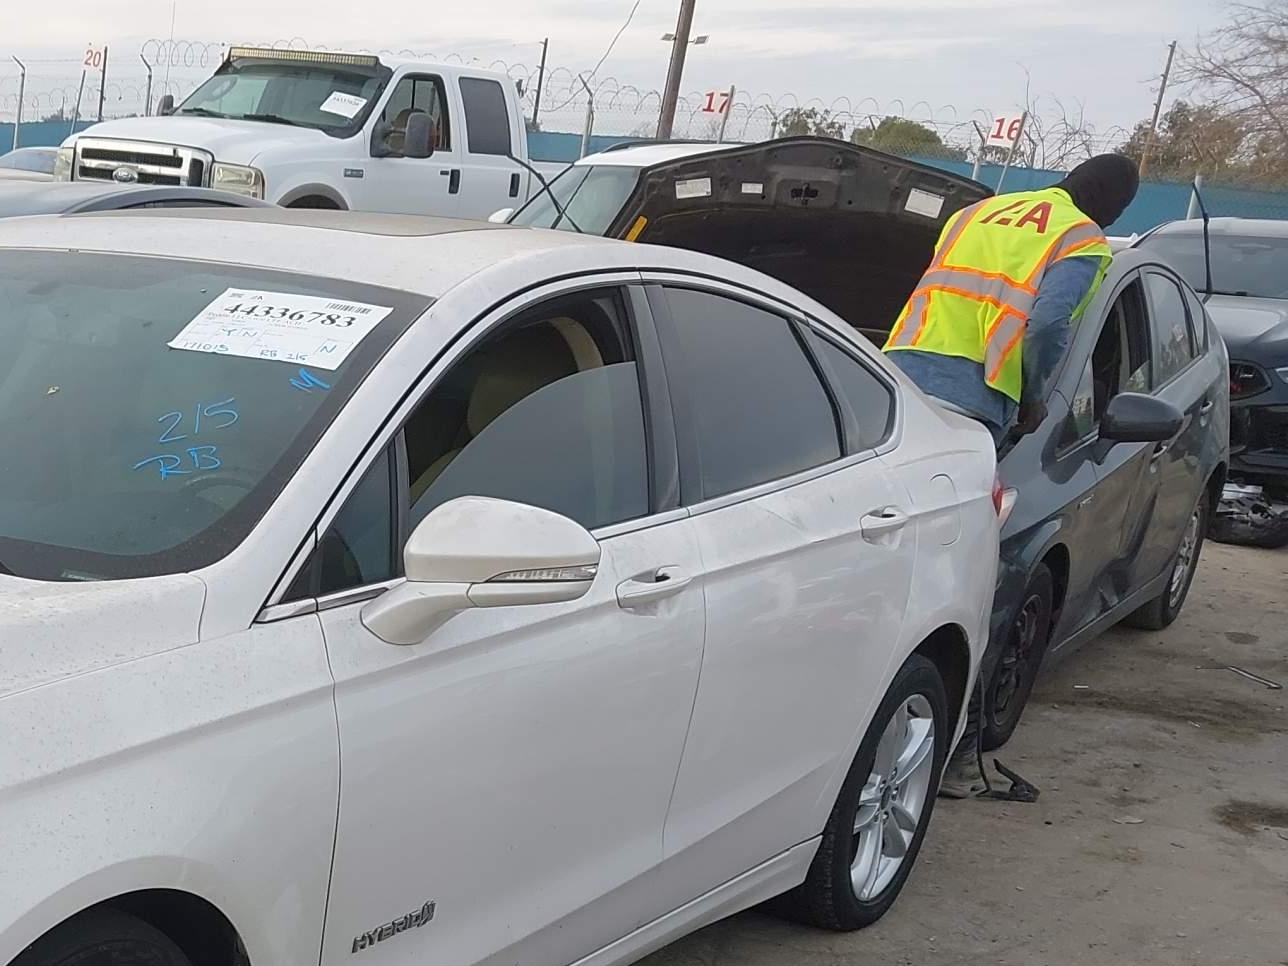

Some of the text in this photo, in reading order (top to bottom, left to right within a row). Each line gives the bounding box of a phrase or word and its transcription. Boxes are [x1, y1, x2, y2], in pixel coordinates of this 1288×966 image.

[84, 50, 102, 67] 20
[703, 91, 729, 113] 17
[991, 117, 1022, 141] 16
[224, 302, 356, 328] 44336783
[320, 344, 337, 354] N
[351, 909, 421, 954] HYBRID
